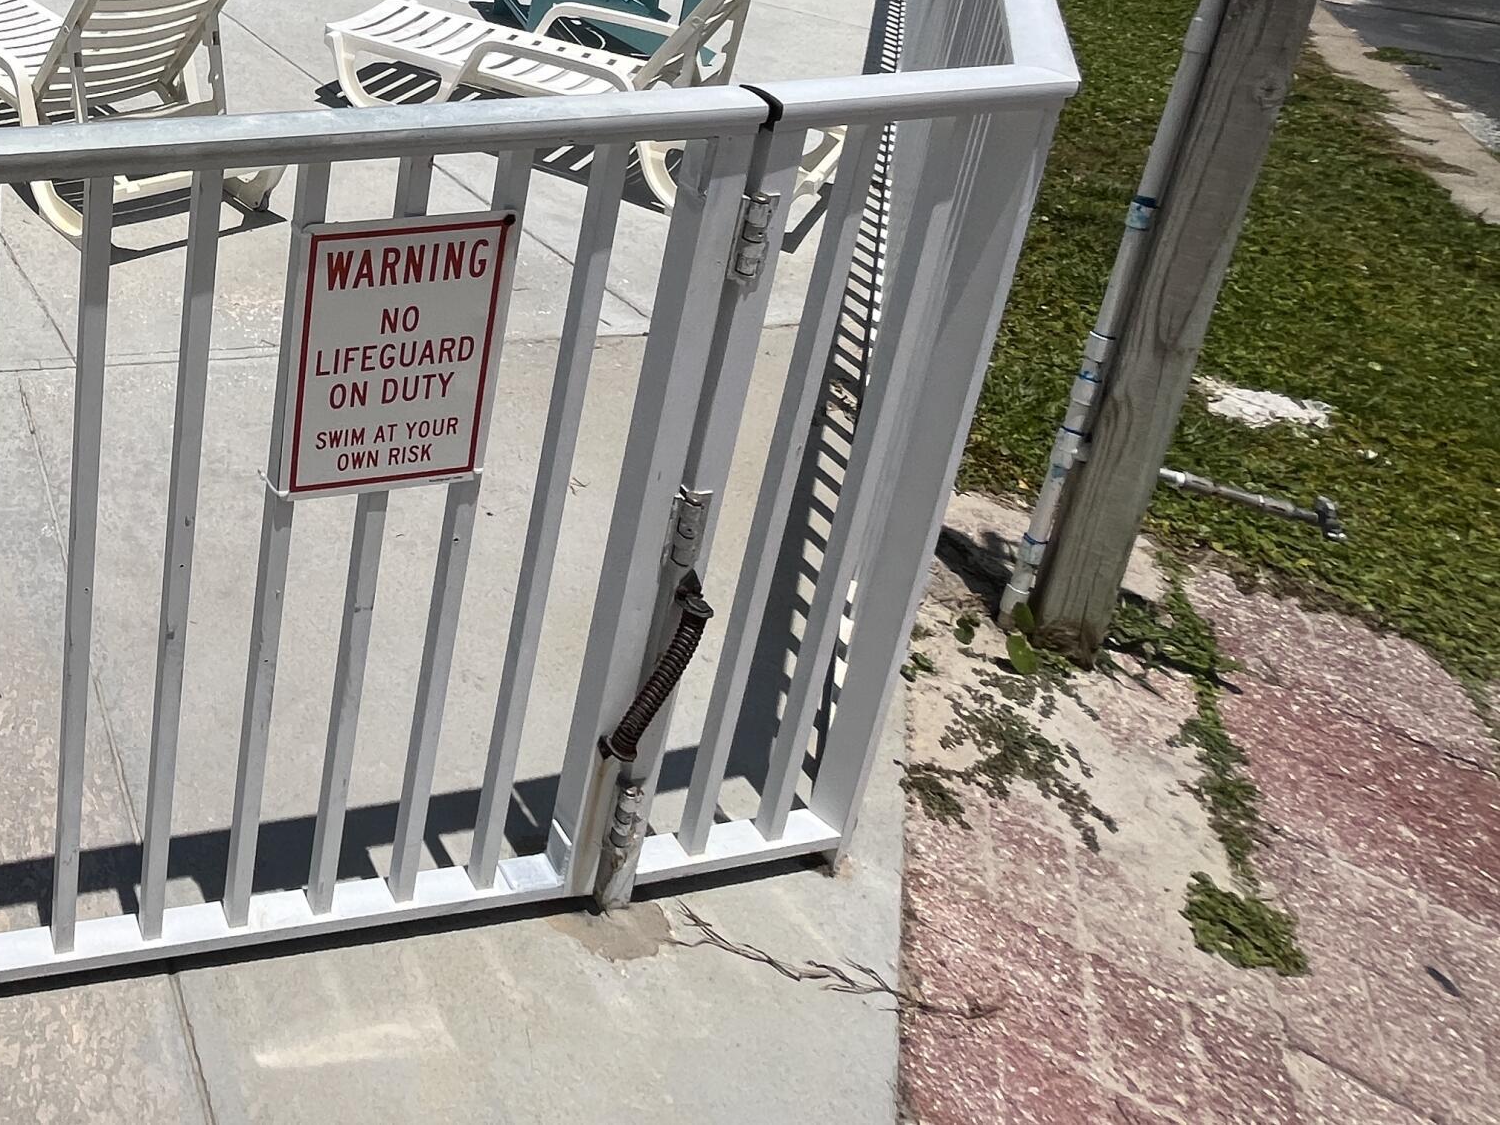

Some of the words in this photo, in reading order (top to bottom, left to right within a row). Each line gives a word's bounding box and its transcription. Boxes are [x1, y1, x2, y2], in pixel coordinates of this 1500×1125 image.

[326, 239, 489, 291] WARNING
[380, 306, 419, 334] NO
[315, 336, 475, 376] LIFEGUARD
[329, 381, 368, 409] ON
[381, 372, 454, 404] DUTY
[315, 427, 365, 450] SWIM
[373, 424, 398, 444] AT
[405, 417, 459, 440] YOUR
[337, 450, 378, 471] OWN
[388, 443, 432, 465] RISK
